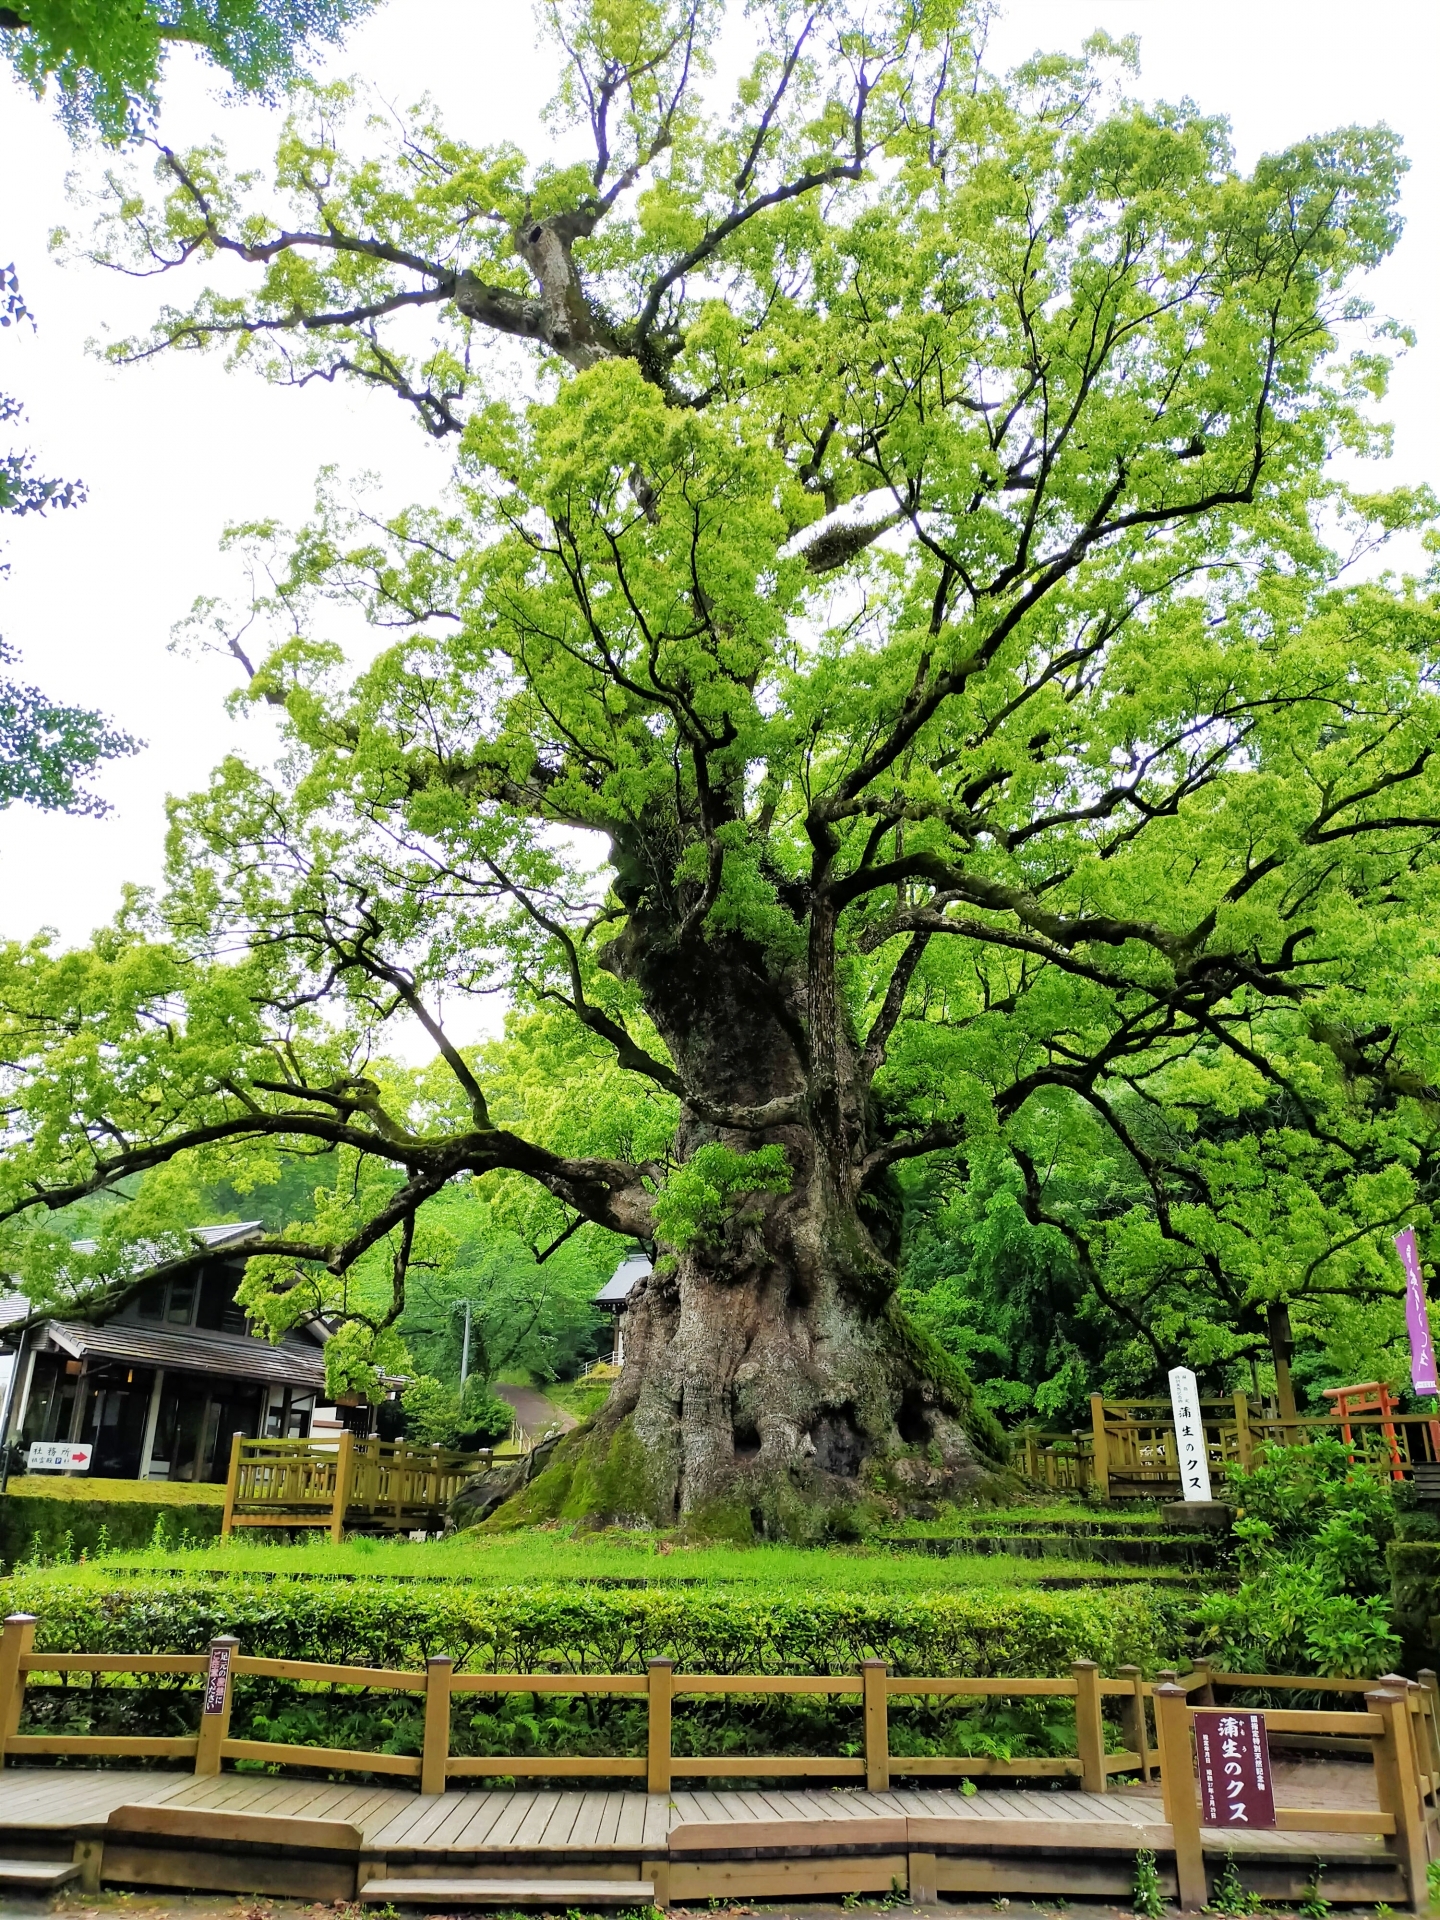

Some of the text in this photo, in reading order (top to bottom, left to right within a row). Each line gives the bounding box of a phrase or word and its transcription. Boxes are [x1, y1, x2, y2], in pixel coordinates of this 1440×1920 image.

[34, 1446, 70, 1457] 社務所
[1179, 1406, 1202, 1489] 蒲生のクス
[1217, 1716, 1249, 1822] 蒲生のクス
[1250, 1715, 1265, 1791] 国指定特別天然記念物
